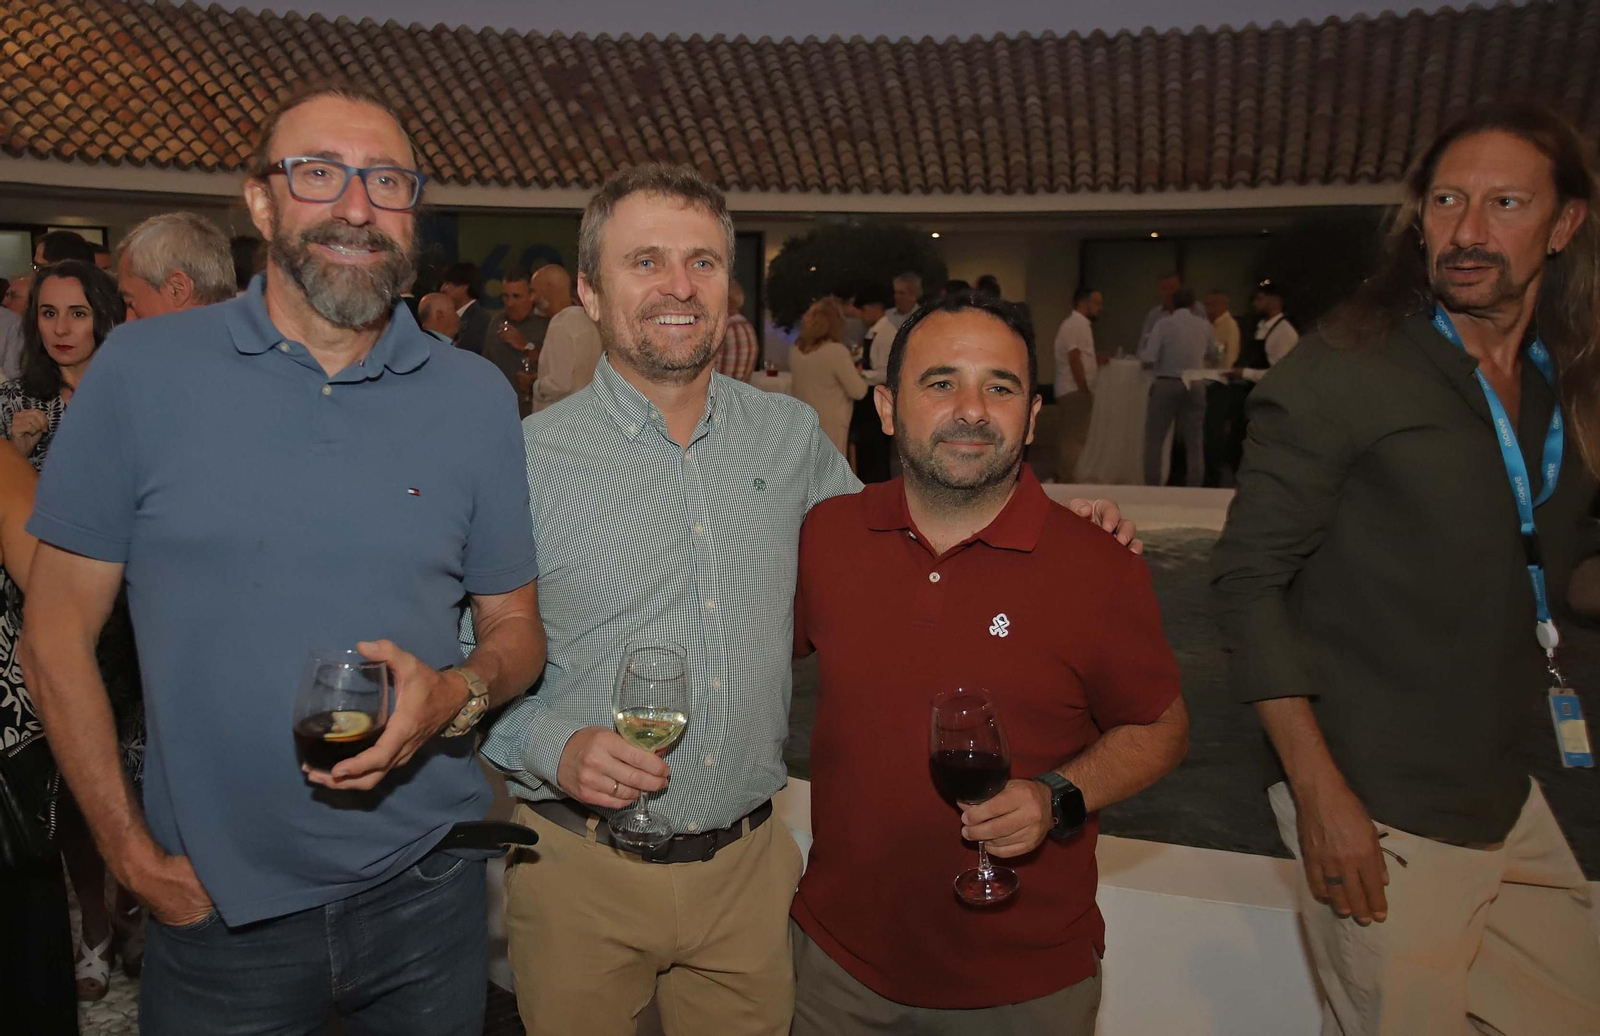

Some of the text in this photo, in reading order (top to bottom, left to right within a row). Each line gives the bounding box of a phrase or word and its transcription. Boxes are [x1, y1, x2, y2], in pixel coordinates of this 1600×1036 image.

[1435, 315, 1453, 338] moeve
[1498, 418, 1512, 447] moeve
[1514, 476, 1526, 506] moeve
